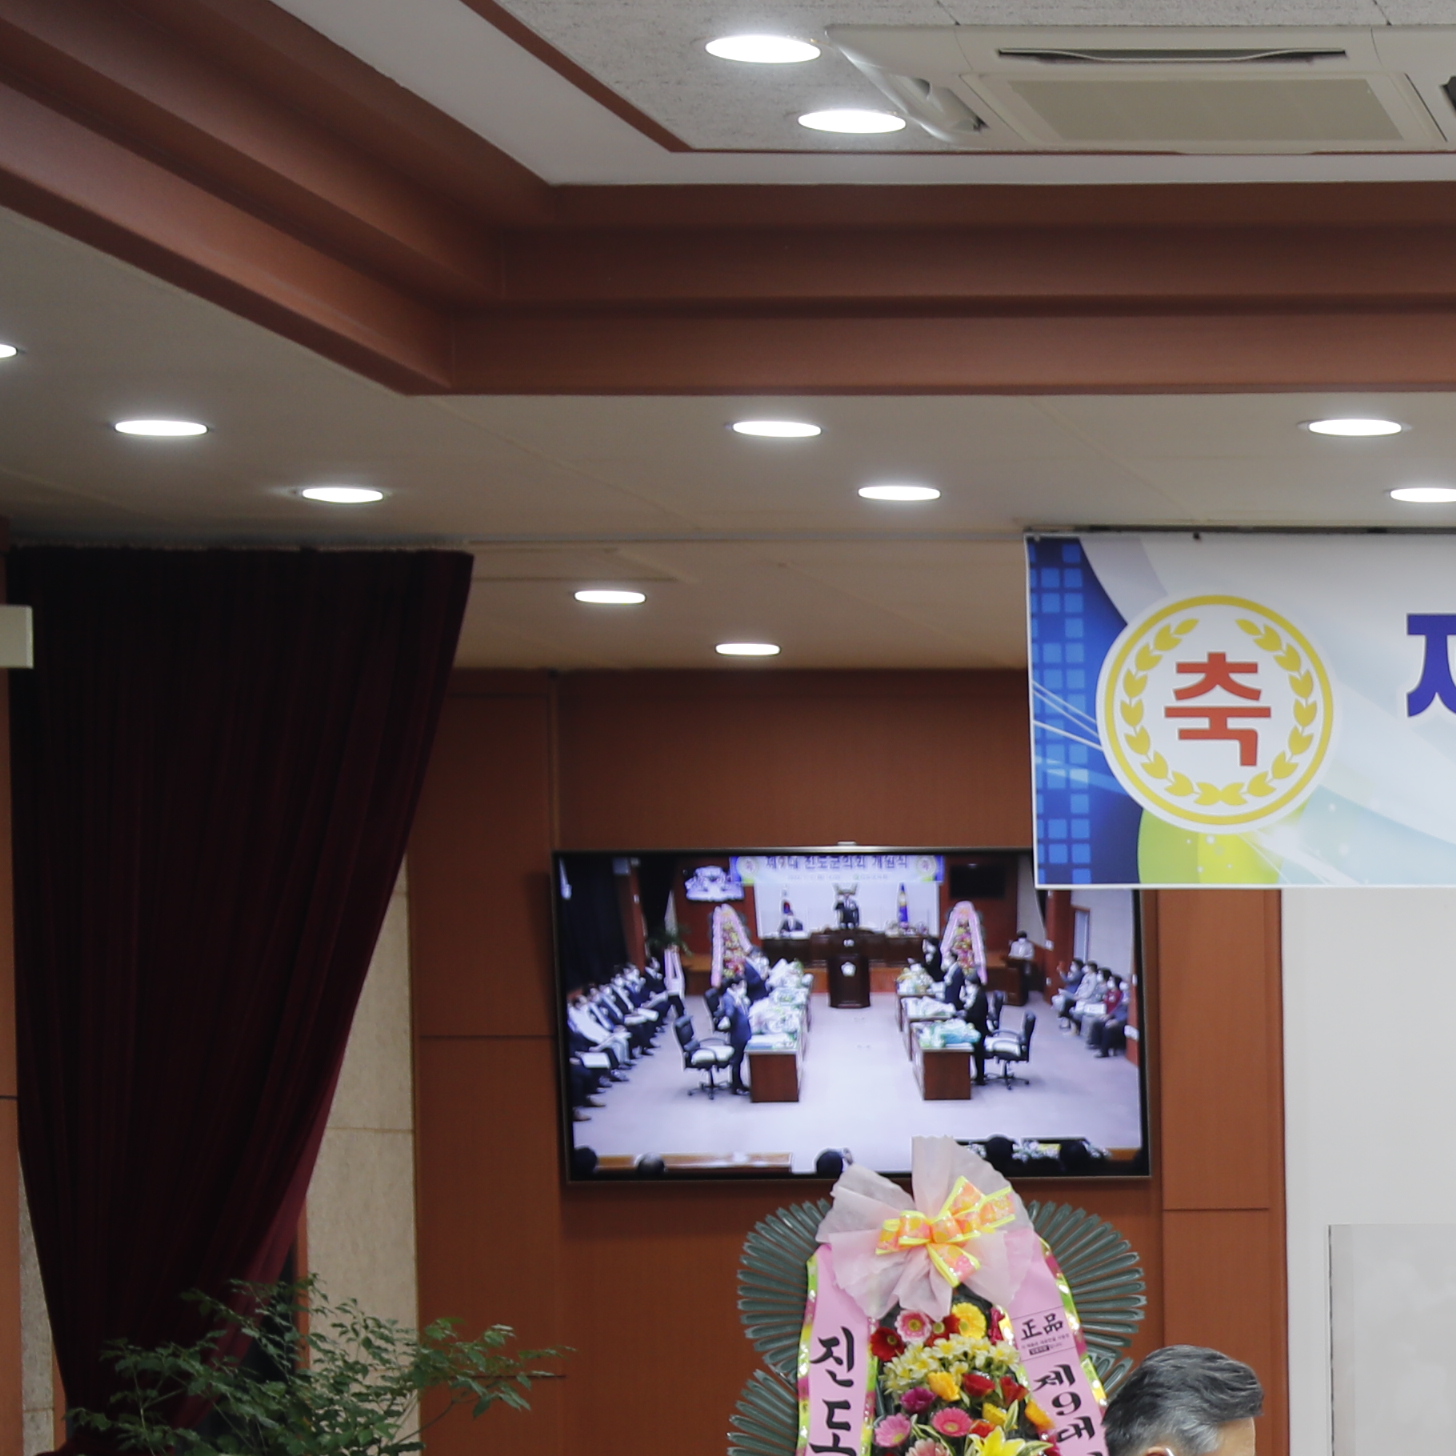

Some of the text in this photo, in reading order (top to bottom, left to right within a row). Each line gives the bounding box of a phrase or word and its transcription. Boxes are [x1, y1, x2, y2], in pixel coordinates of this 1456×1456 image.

[1164, 651, 1271, 767] 축
[1021, 1313, 1064, 1341] 正品
[1032, 1364, 1096, 1443] 제9대
